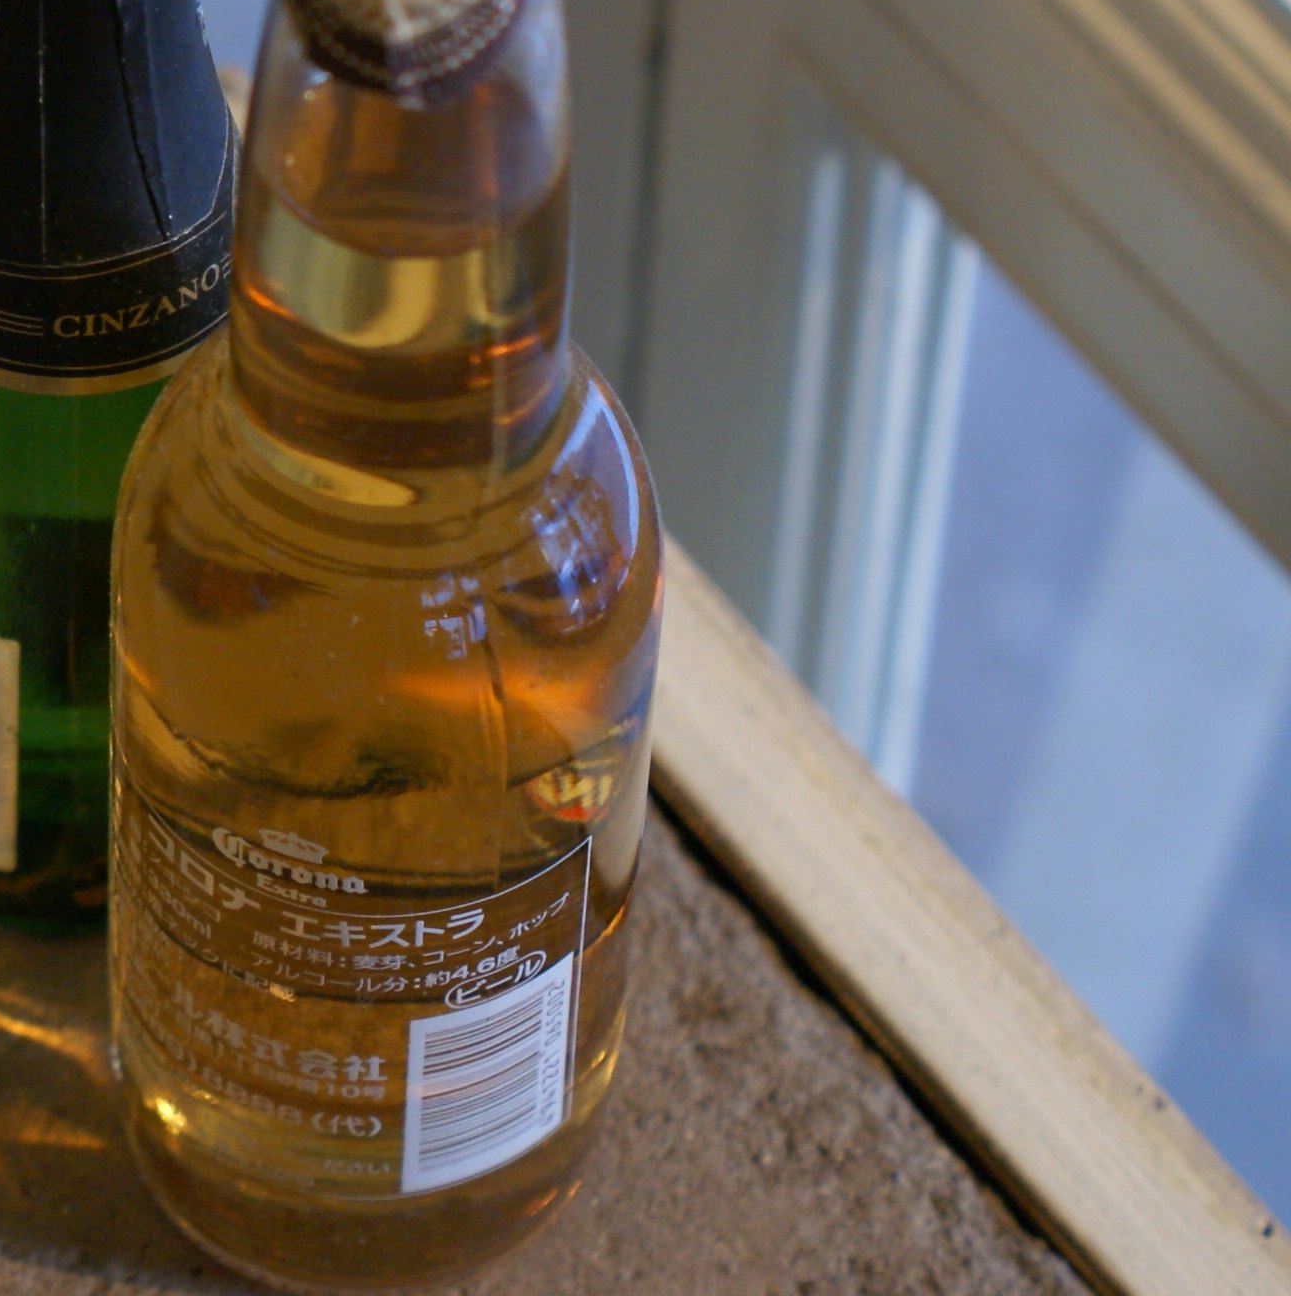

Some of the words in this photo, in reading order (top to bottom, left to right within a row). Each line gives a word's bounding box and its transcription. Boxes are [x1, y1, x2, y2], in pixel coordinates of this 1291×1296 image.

[52, 263, 221, 339] CINZANO
[147, 812, 262, 911] コロナ
[279, 907, 486, 949] エキストラ
[211, 826, 369, 896] Corona
[256, 872, 328, 908] Extra
[456, 958, 542, 1005] ビール
